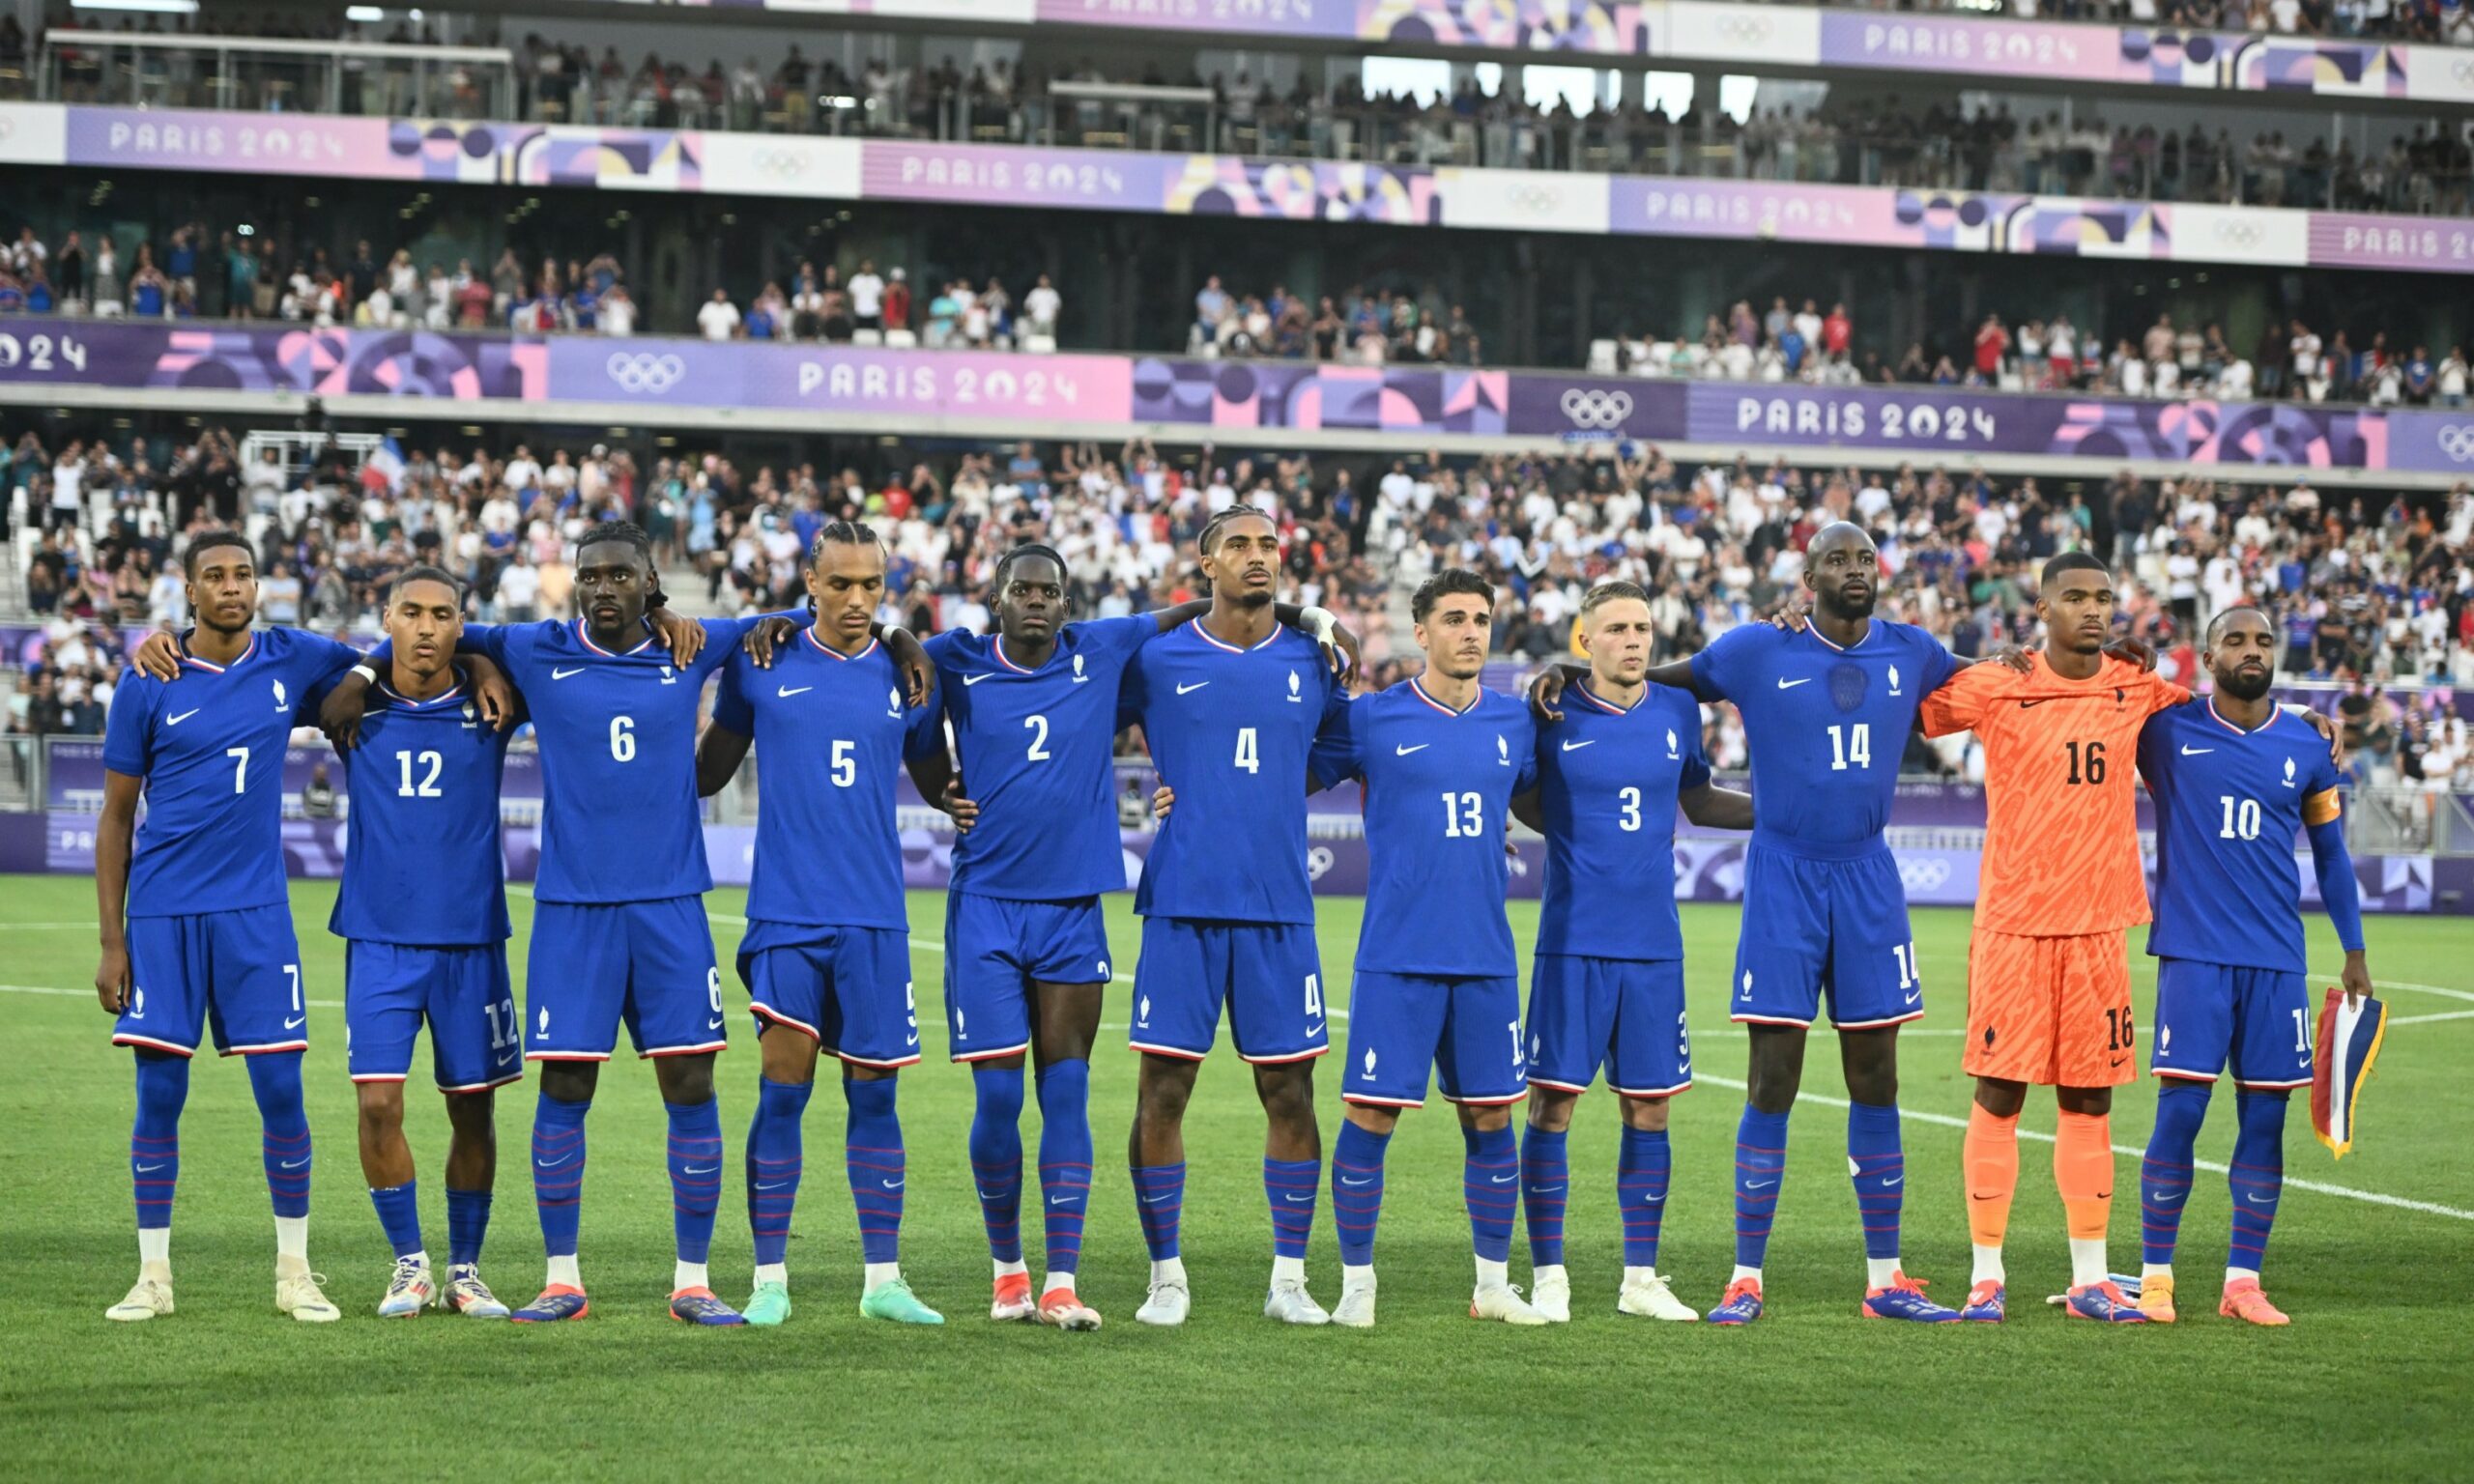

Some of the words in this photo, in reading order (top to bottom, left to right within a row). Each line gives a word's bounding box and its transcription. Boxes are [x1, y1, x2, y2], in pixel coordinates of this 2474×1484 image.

[1865, 24, 1971, 60] PARIS
[1983, 30, 2077, 65] 2024
[109, 122, 225, 157] PARIS
[239, 127, 343, 161] 2024
[901, 156, 1013, 190] PARIS
[1022, 161, 1122, 194] 2024
[1647, 191, 1750, 223] PARIS
[1761, 196, 1854, 229] 2024
[2344, 226, 2438, 258] PARIS
[798, 361, 937, 401] PARIS
[954, 367, 1078, 406] 2024
[1737, 397, 1865, 437] PARIS
[1880, 402, 1995, 442] 2024
[610, 716, 636, 762] 6
[1024, 714, 1050, 761] 2
[1234, 728, 1260, 774] 4
[1827, 724, 1871, 770] 14
[226, 747, 249, 794] 7
[395, 751, 443, 797] 12
[831, 739, 855, 787] 5
[2065, 741, 2106, 785] 16
[1442, 791, 1483, 838] 13
[1619, 786, 1641, 832] 3
[2220, 795, 2261, 841] 10
[283, 964, 300, 1012] 7
[707, 966, 723, 1013] 6
[1305, 973, 1322, 1018] 4
[485, 998, 519, 1050] 12
[2107, 1005, 2134, 1051] 16
